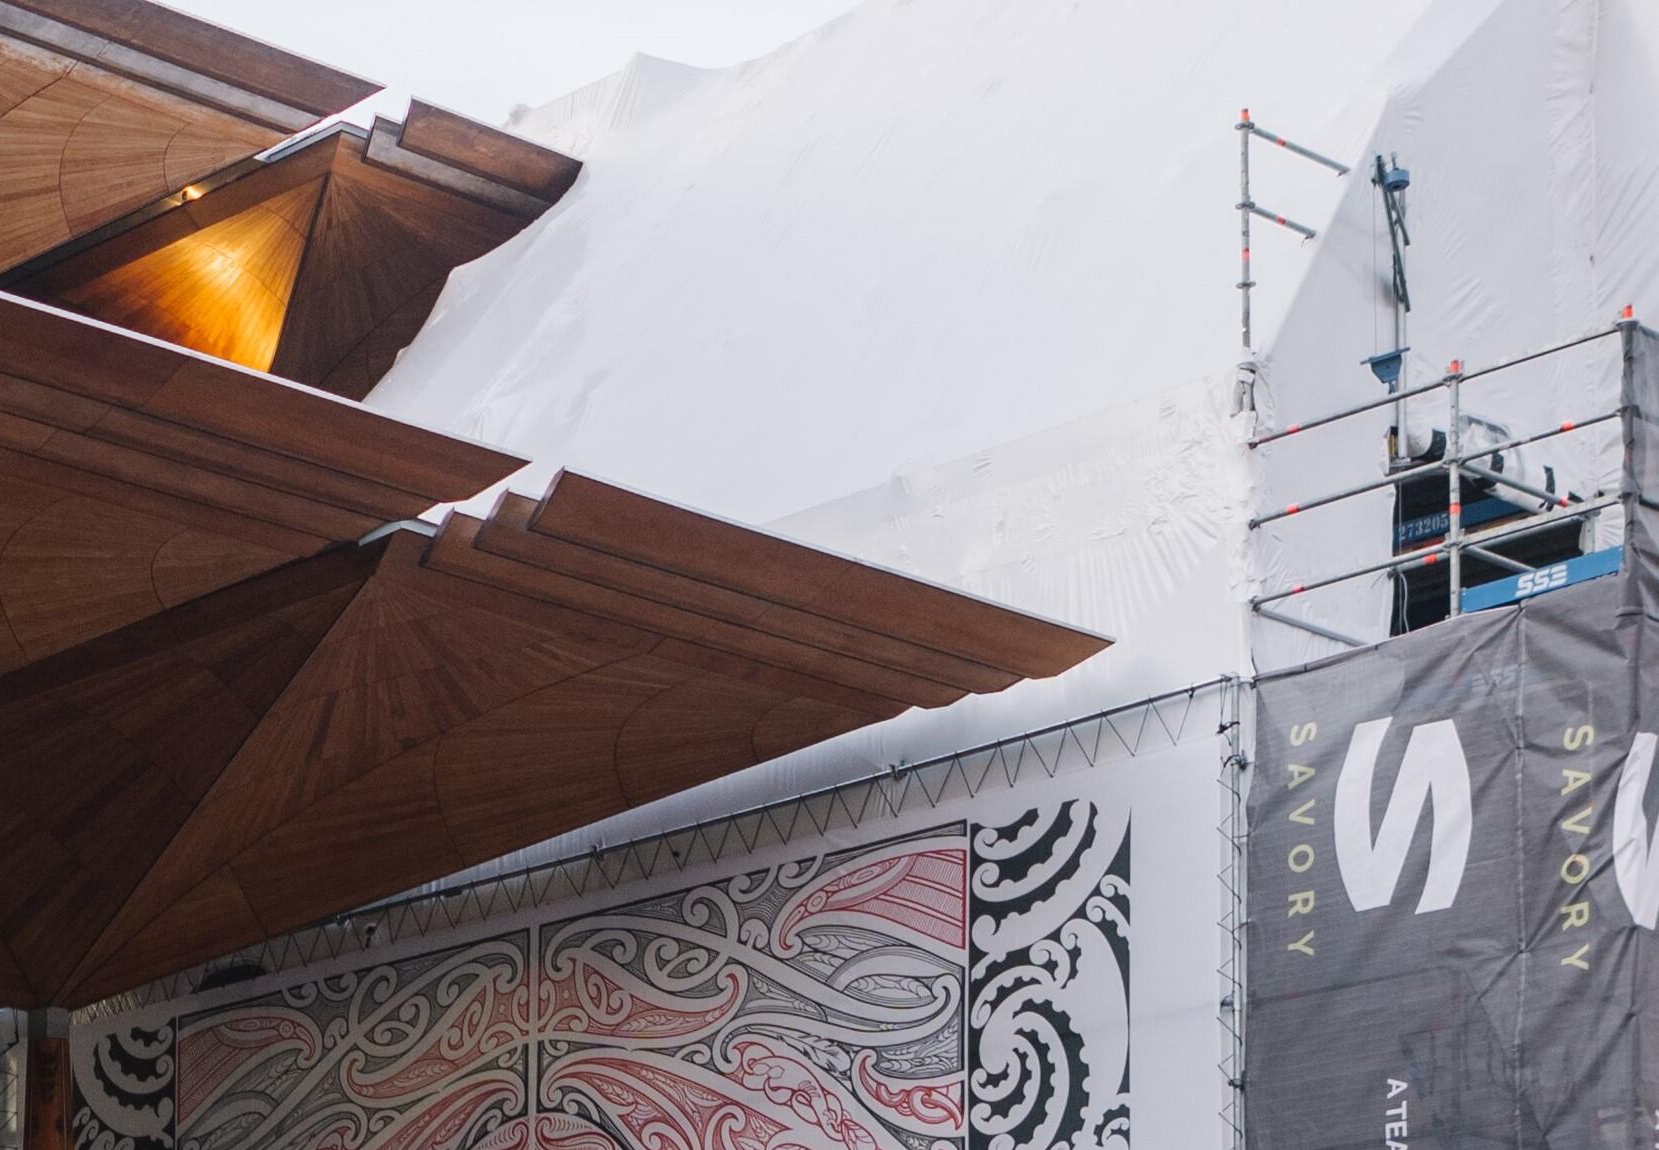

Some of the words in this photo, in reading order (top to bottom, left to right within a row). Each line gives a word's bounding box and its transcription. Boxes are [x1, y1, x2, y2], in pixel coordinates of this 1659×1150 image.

[1287, 722, 1318, 957] SAVORY
[1559, 724, 1596, 971] SAVORY
[1386, 1078, 1409, 1099] A
